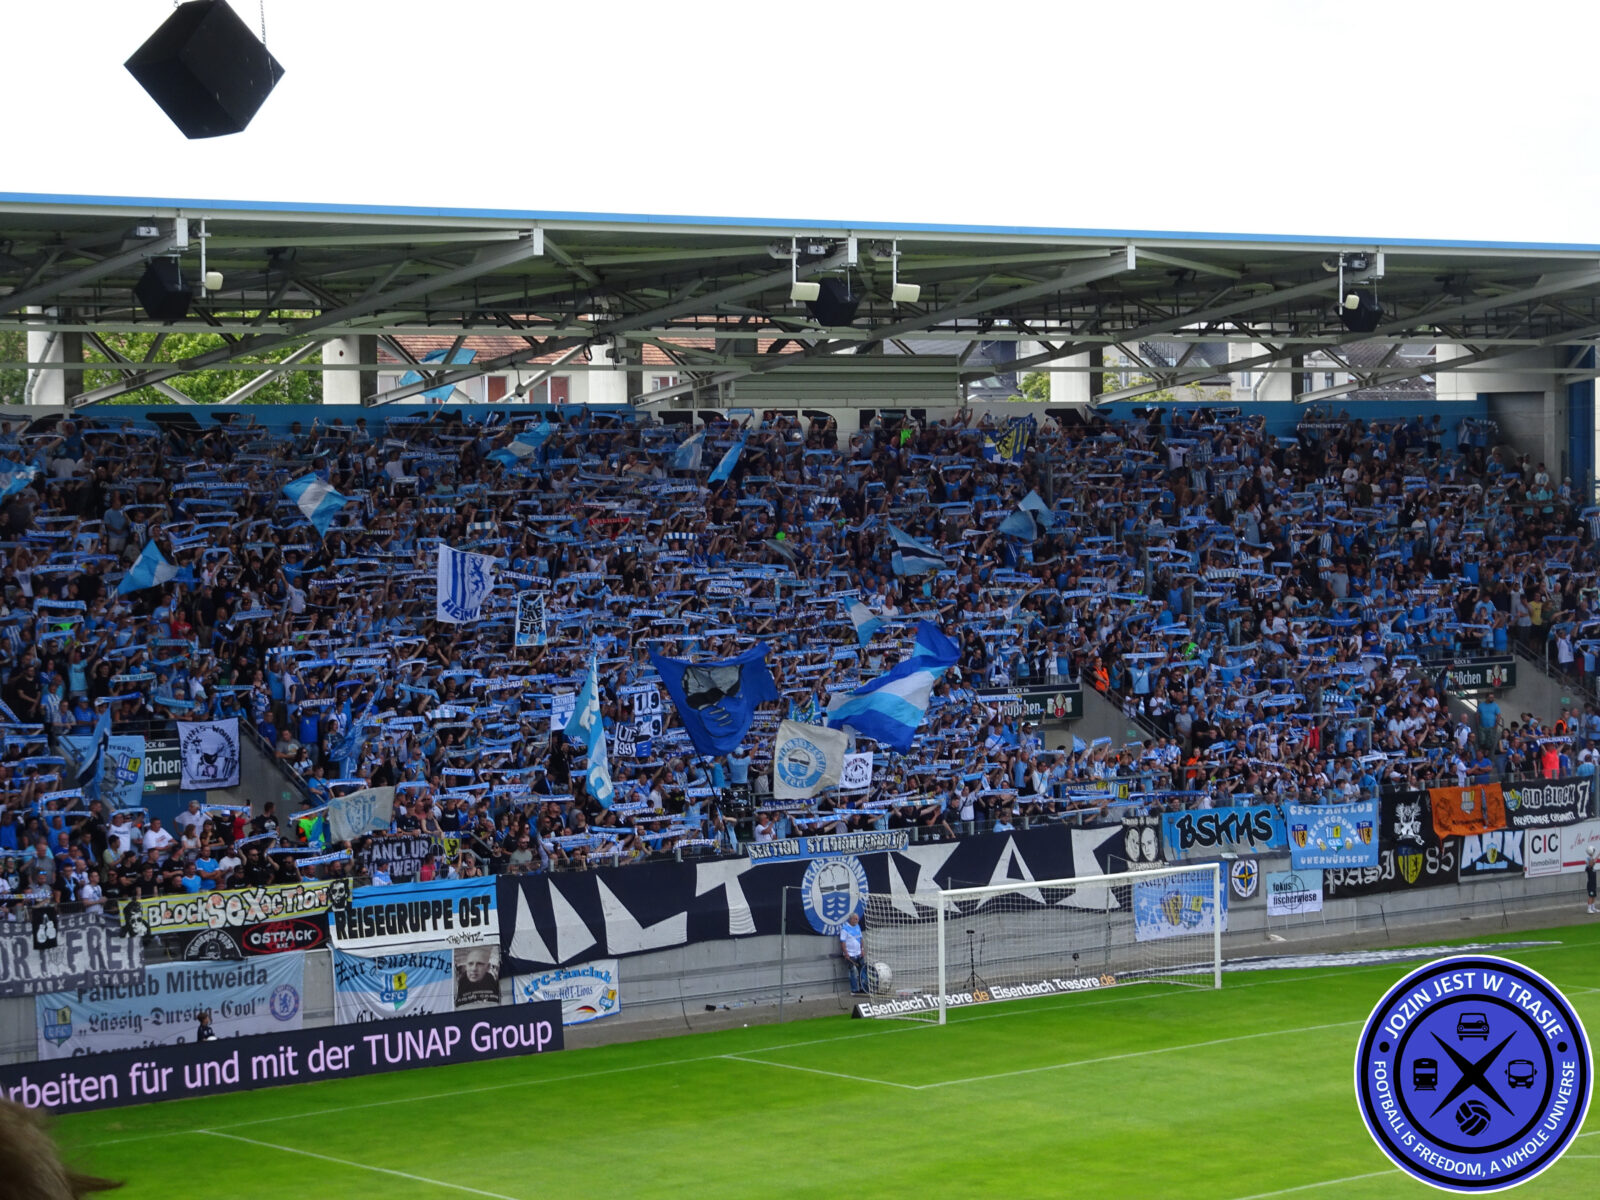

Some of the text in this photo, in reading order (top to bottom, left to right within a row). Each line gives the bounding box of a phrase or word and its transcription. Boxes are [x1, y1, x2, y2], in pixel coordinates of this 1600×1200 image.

[1522, 787, 1542, 809] OLD
[1543, 784, 1576, 807] BLOCK
[1531, 833, 1559, 854] CIC
[335, 895, 492, 940] REISEGRUPPE OST
[166, 966, 268, 996] Mittweida
[383, 990, 404, 1001] CFC
[860, 996, 923, 1018] Eisenbach
[990, 978, 1052, 1000] Eisenbach
[1053, 973, 1117, 991] Tresore.de
[2, 1020, 553, 1110] rbeiten für und mit der TUNAP Group
